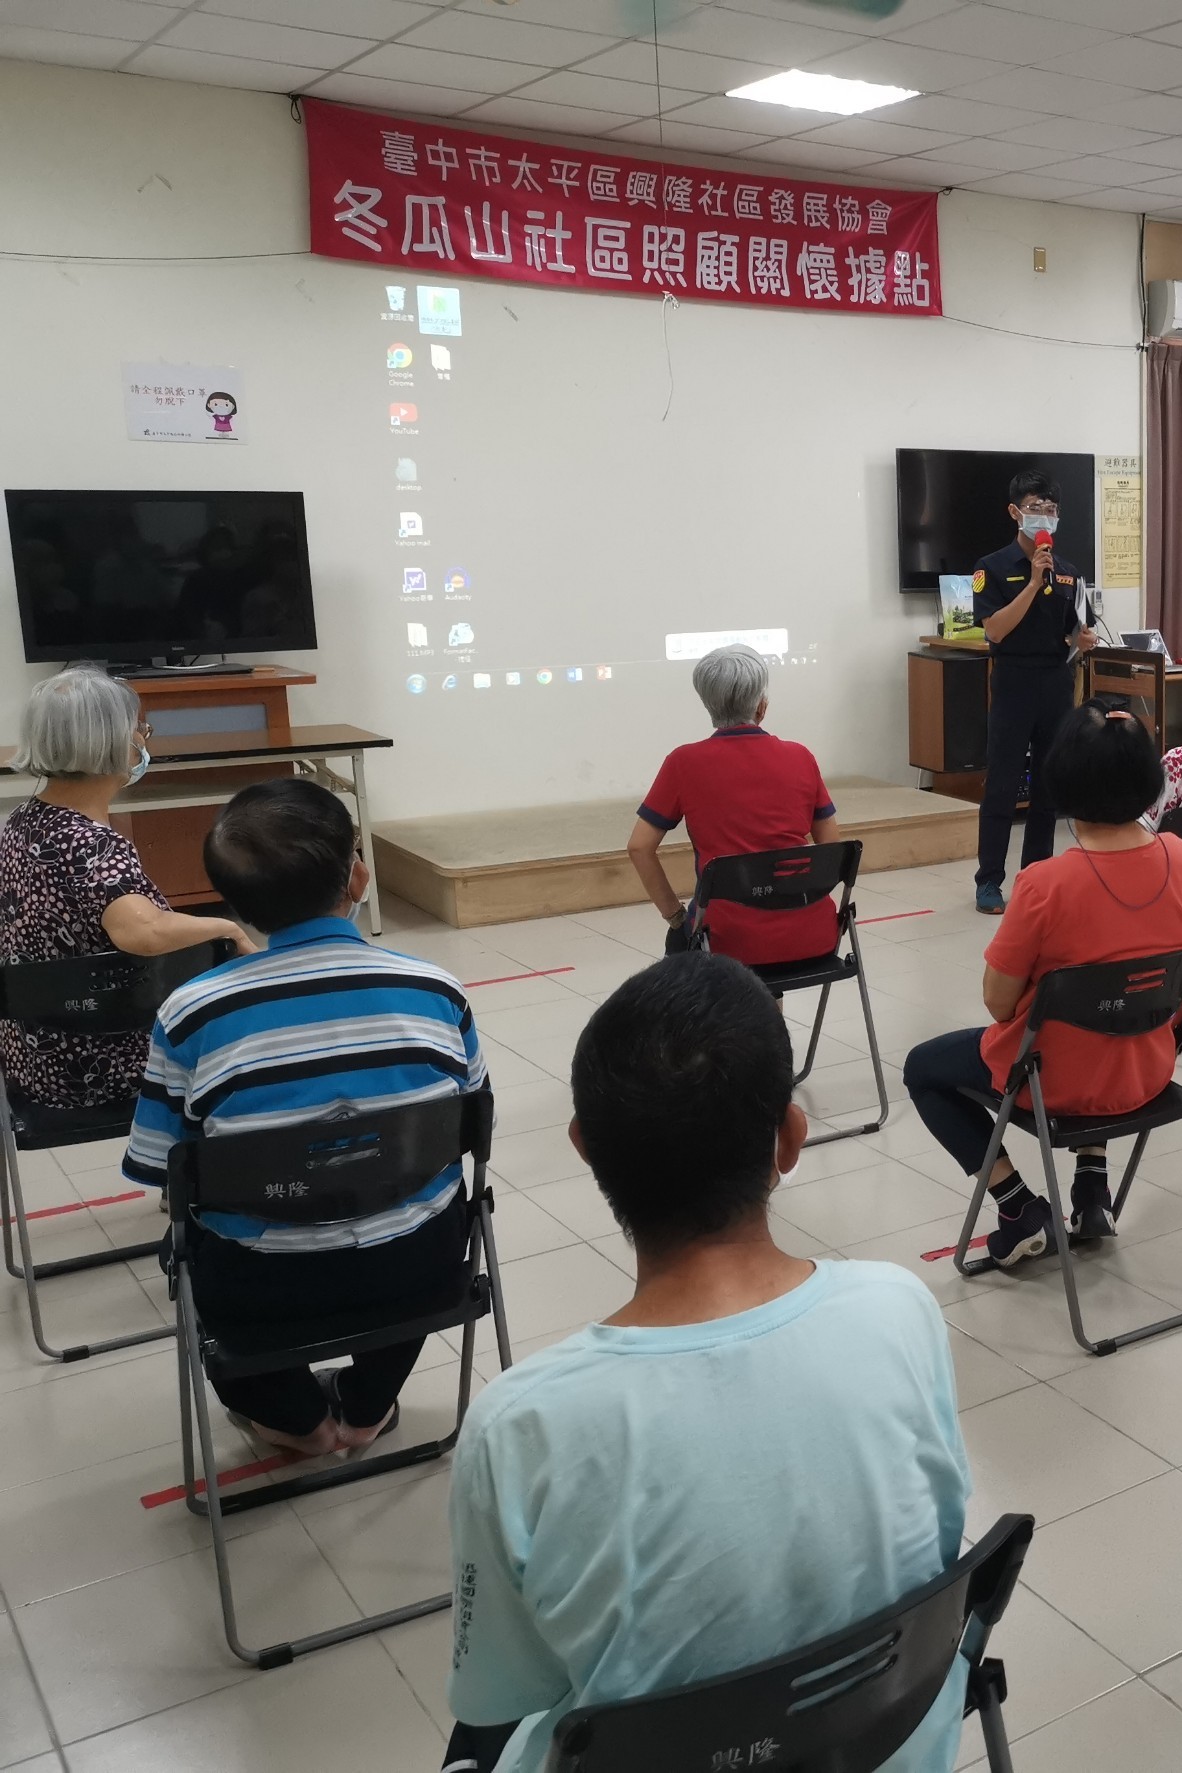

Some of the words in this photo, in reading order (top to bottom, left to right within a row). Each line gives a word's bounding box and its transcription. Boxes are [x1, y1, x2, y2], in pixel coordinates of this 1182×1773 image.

[379, 130, 892, 237] 臺中市太平區興隆社區發展協會
[332, 178, 931, 308] 冬瓜山社區照顧關懷據點
[388, 370, 413, 379] Google
[388, 379, 414, 387] Chrome
[390, 427, 419, 435] YouTube
[65, 998, 98, 1012] 興隆
[1097, 999, 1126, 1012] 興隆
[264, 1181, 310, 1200] 興隆
[711, 1737, 780, 1772] 興隆
